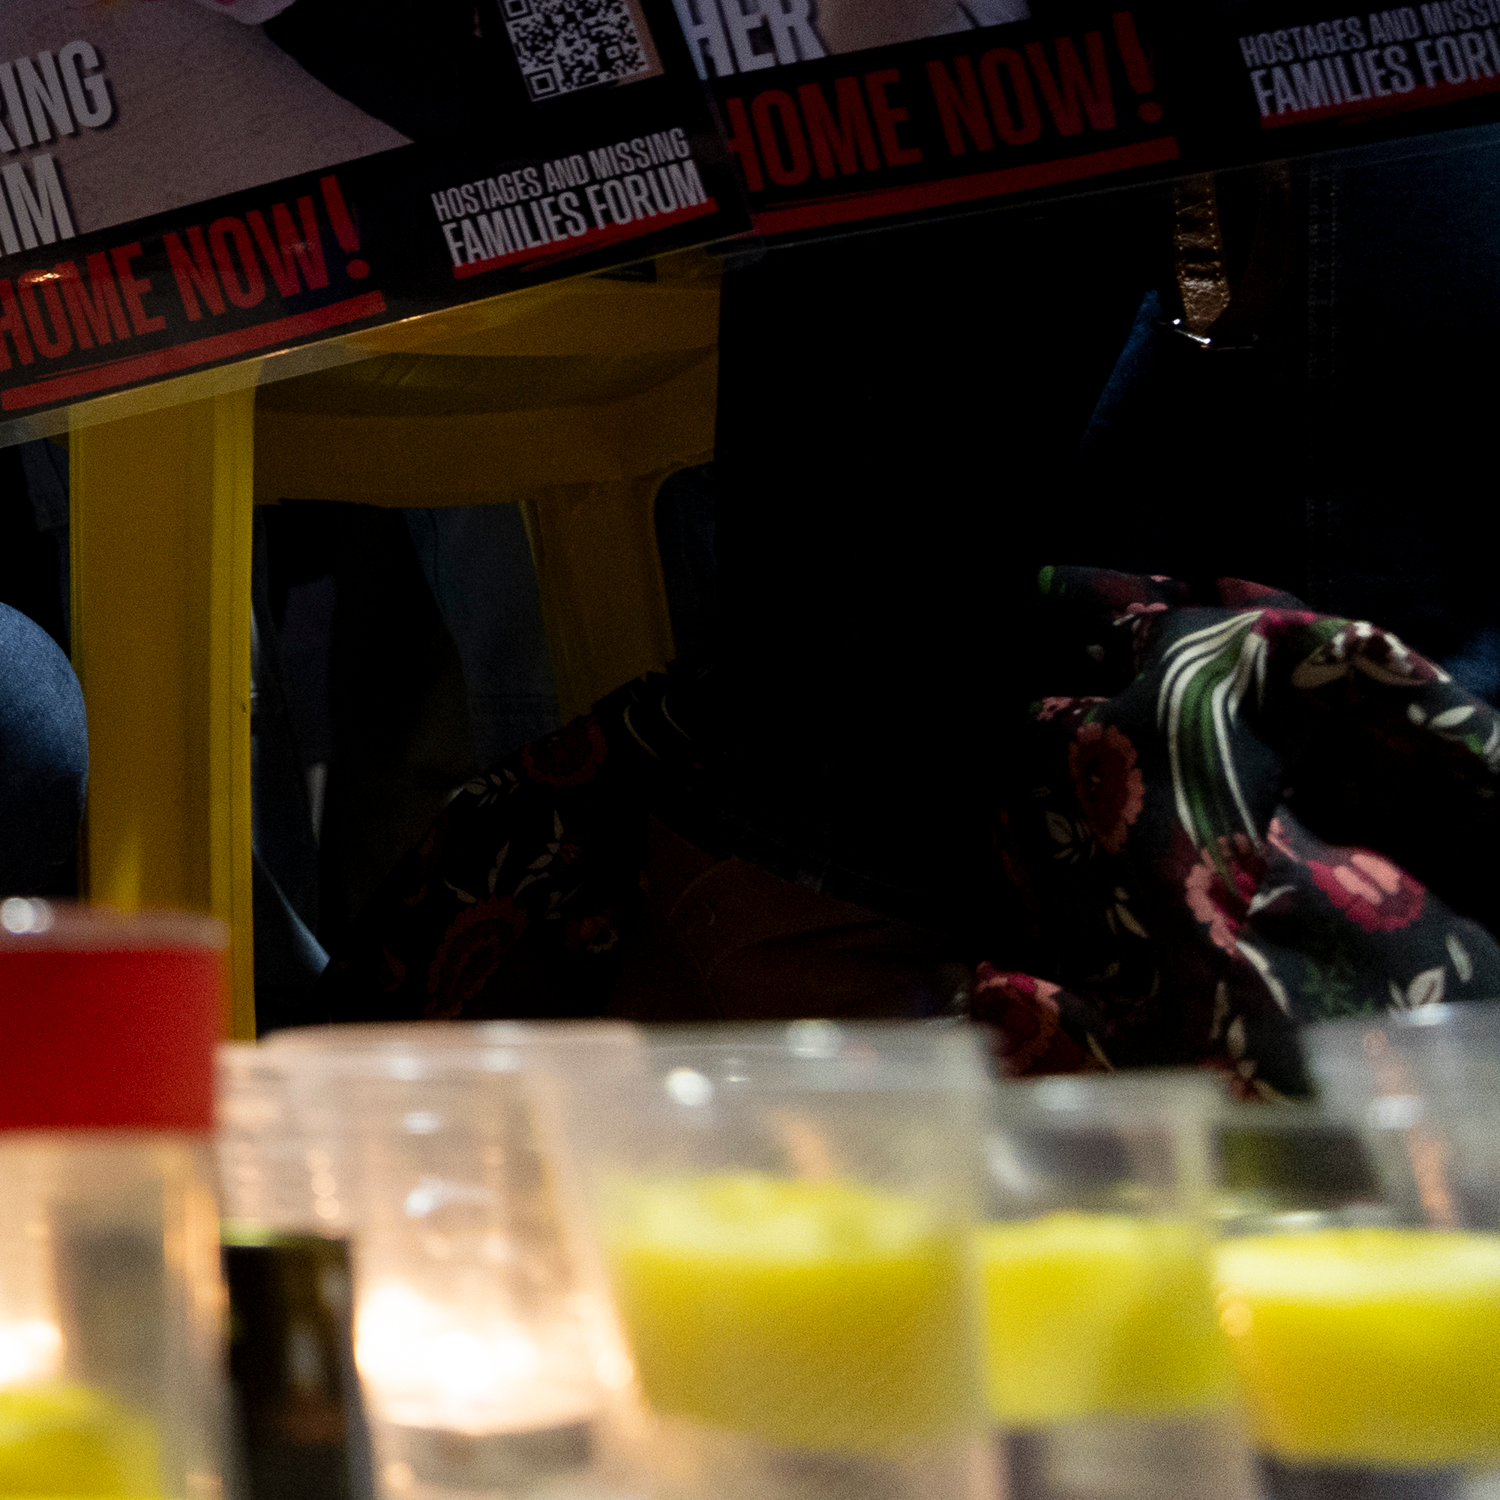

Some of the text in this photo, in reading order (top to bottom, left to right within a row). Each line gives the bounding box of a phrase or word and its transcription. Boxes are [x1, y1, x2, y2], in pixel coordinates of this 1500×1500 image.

[924, 10, 1165, 158] NOW!
[1238, 15, 1367, 68] HOSTAGES
[1368, 6, 1422, 46] AND
[1250, 44, 1416, 117] FAMILIES
[430, 126, 690, 223] HOSTAGES AND MISSING
[441, 158, 708, 268] FAMILIES FORUM
[162, 174, 371, 323] NOW!
